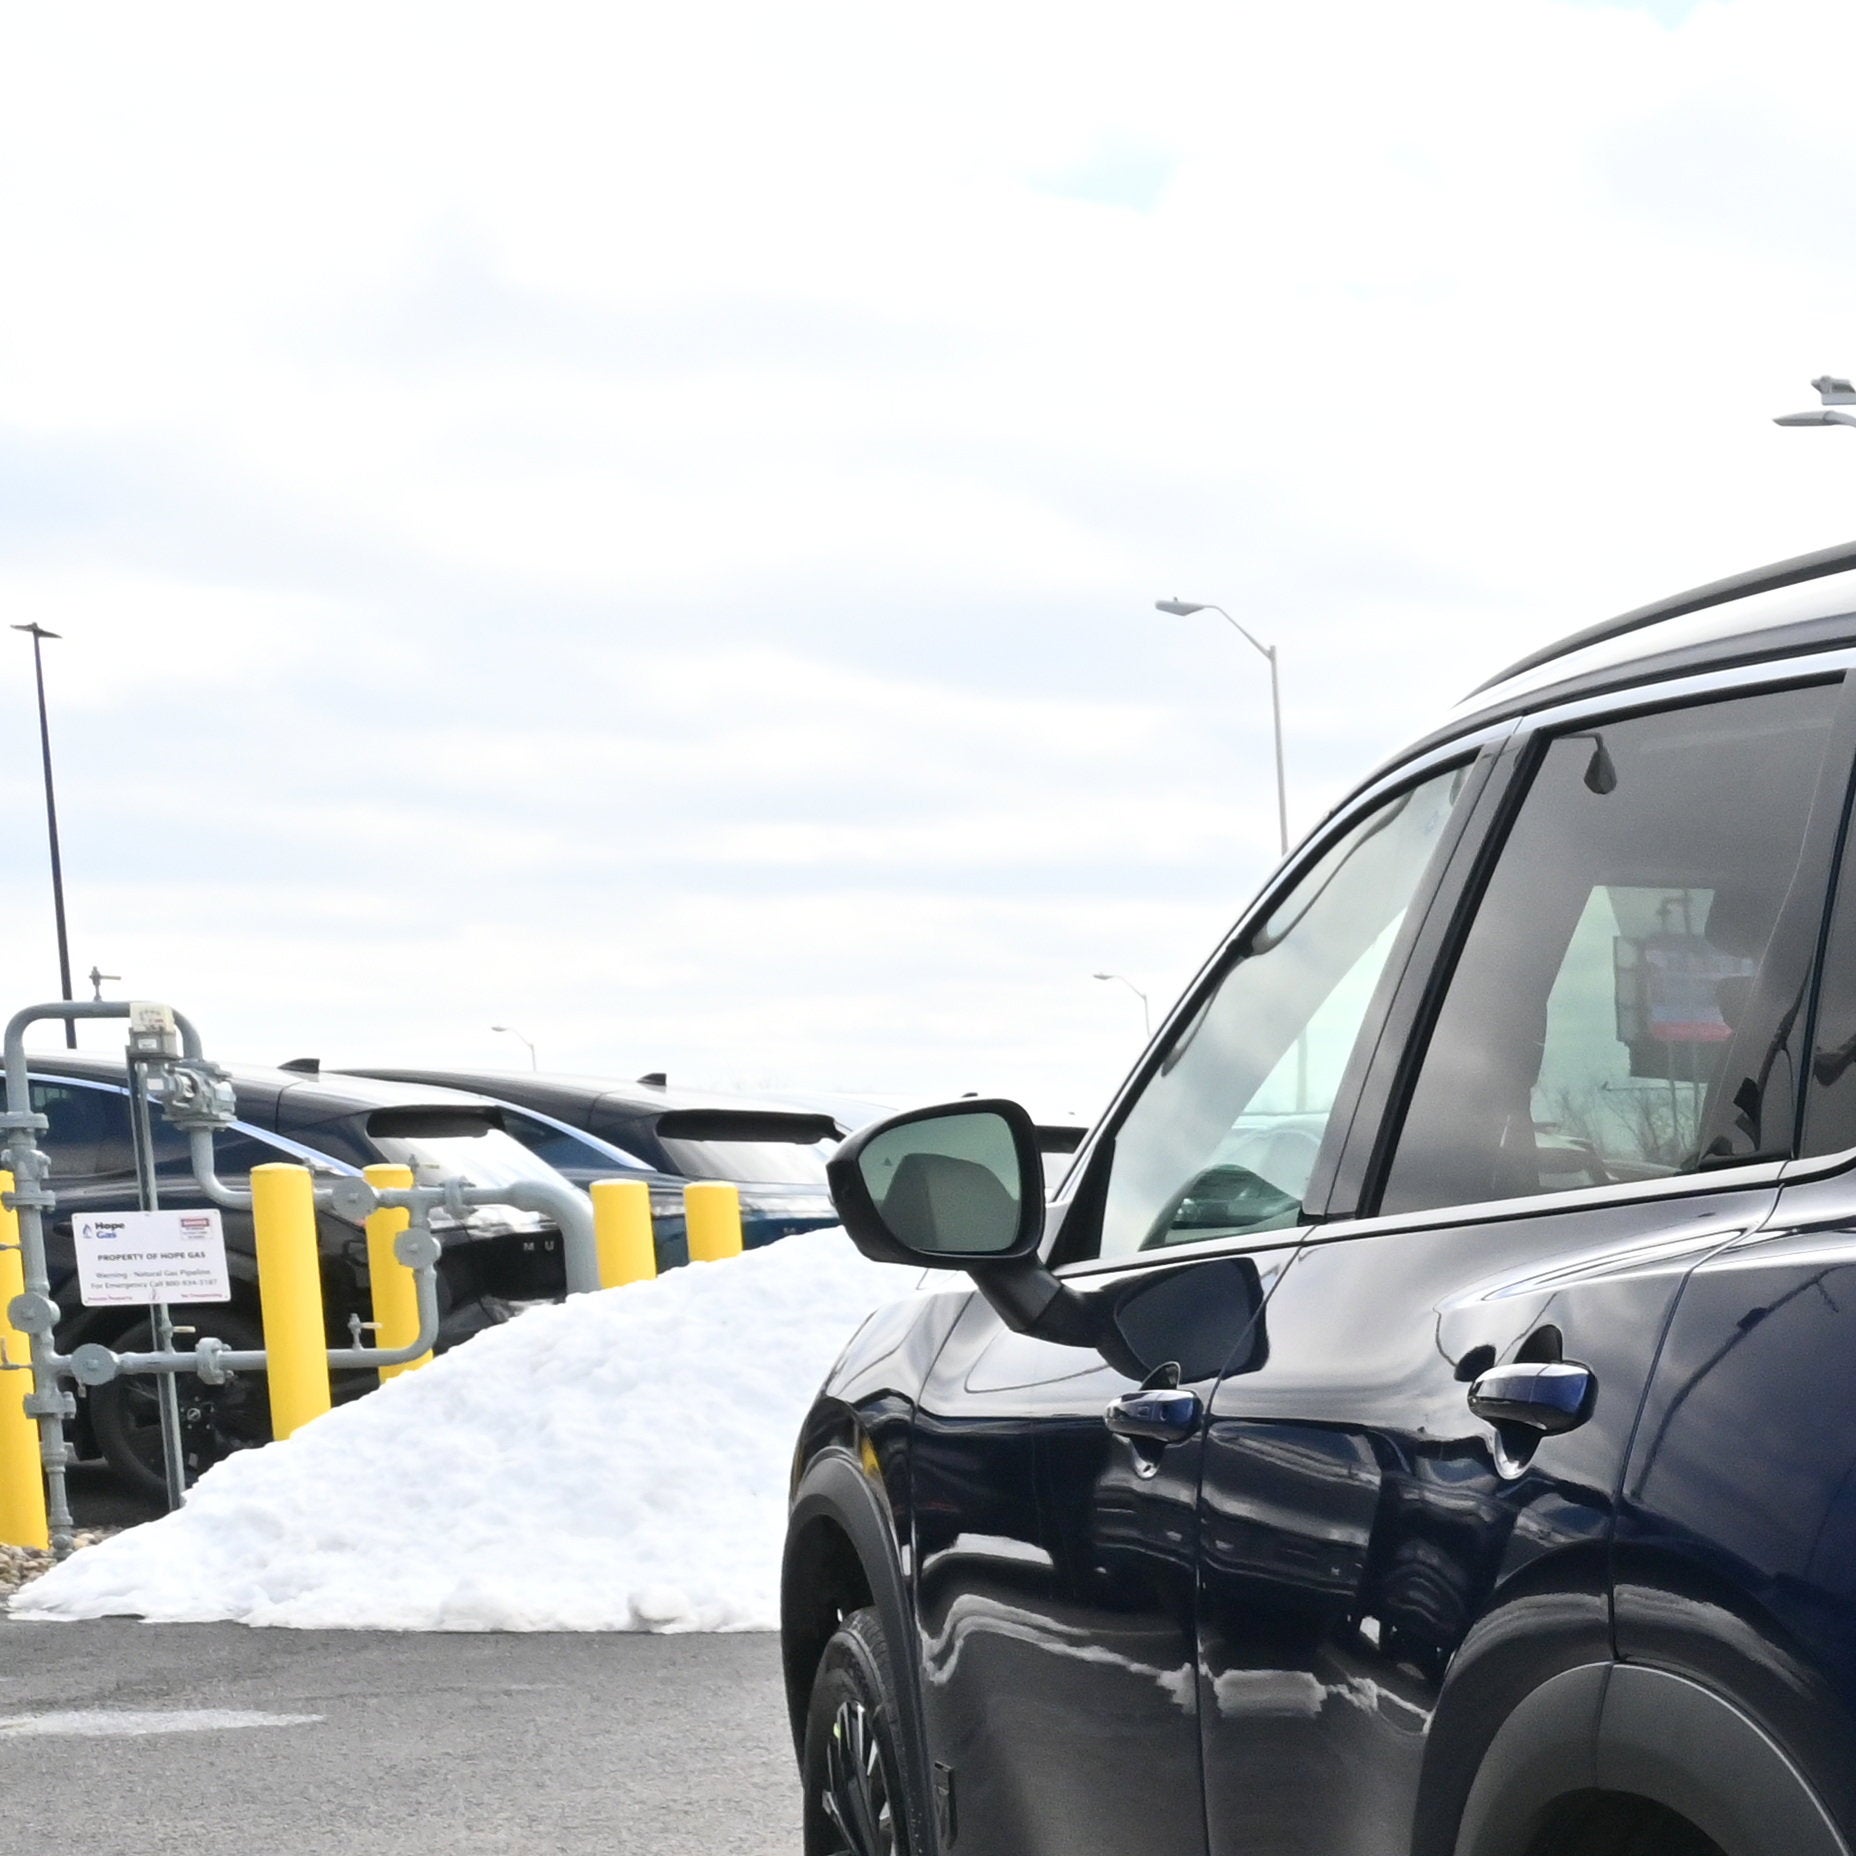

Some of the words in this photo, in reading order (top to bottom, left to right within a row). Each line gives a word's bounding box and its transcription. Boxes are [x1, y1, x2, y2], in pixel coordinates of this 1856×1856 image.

[95, 1221, 125, 1231] Hope
[96, 1231, 117, 1239] Gas
[97, 1253, 143, 1261] PROPERTY
[146, 1252, 157, 1260] OF
[160, 1251, 185, 1260] HOPE
[187, 1251, 206, 1259] GAS
